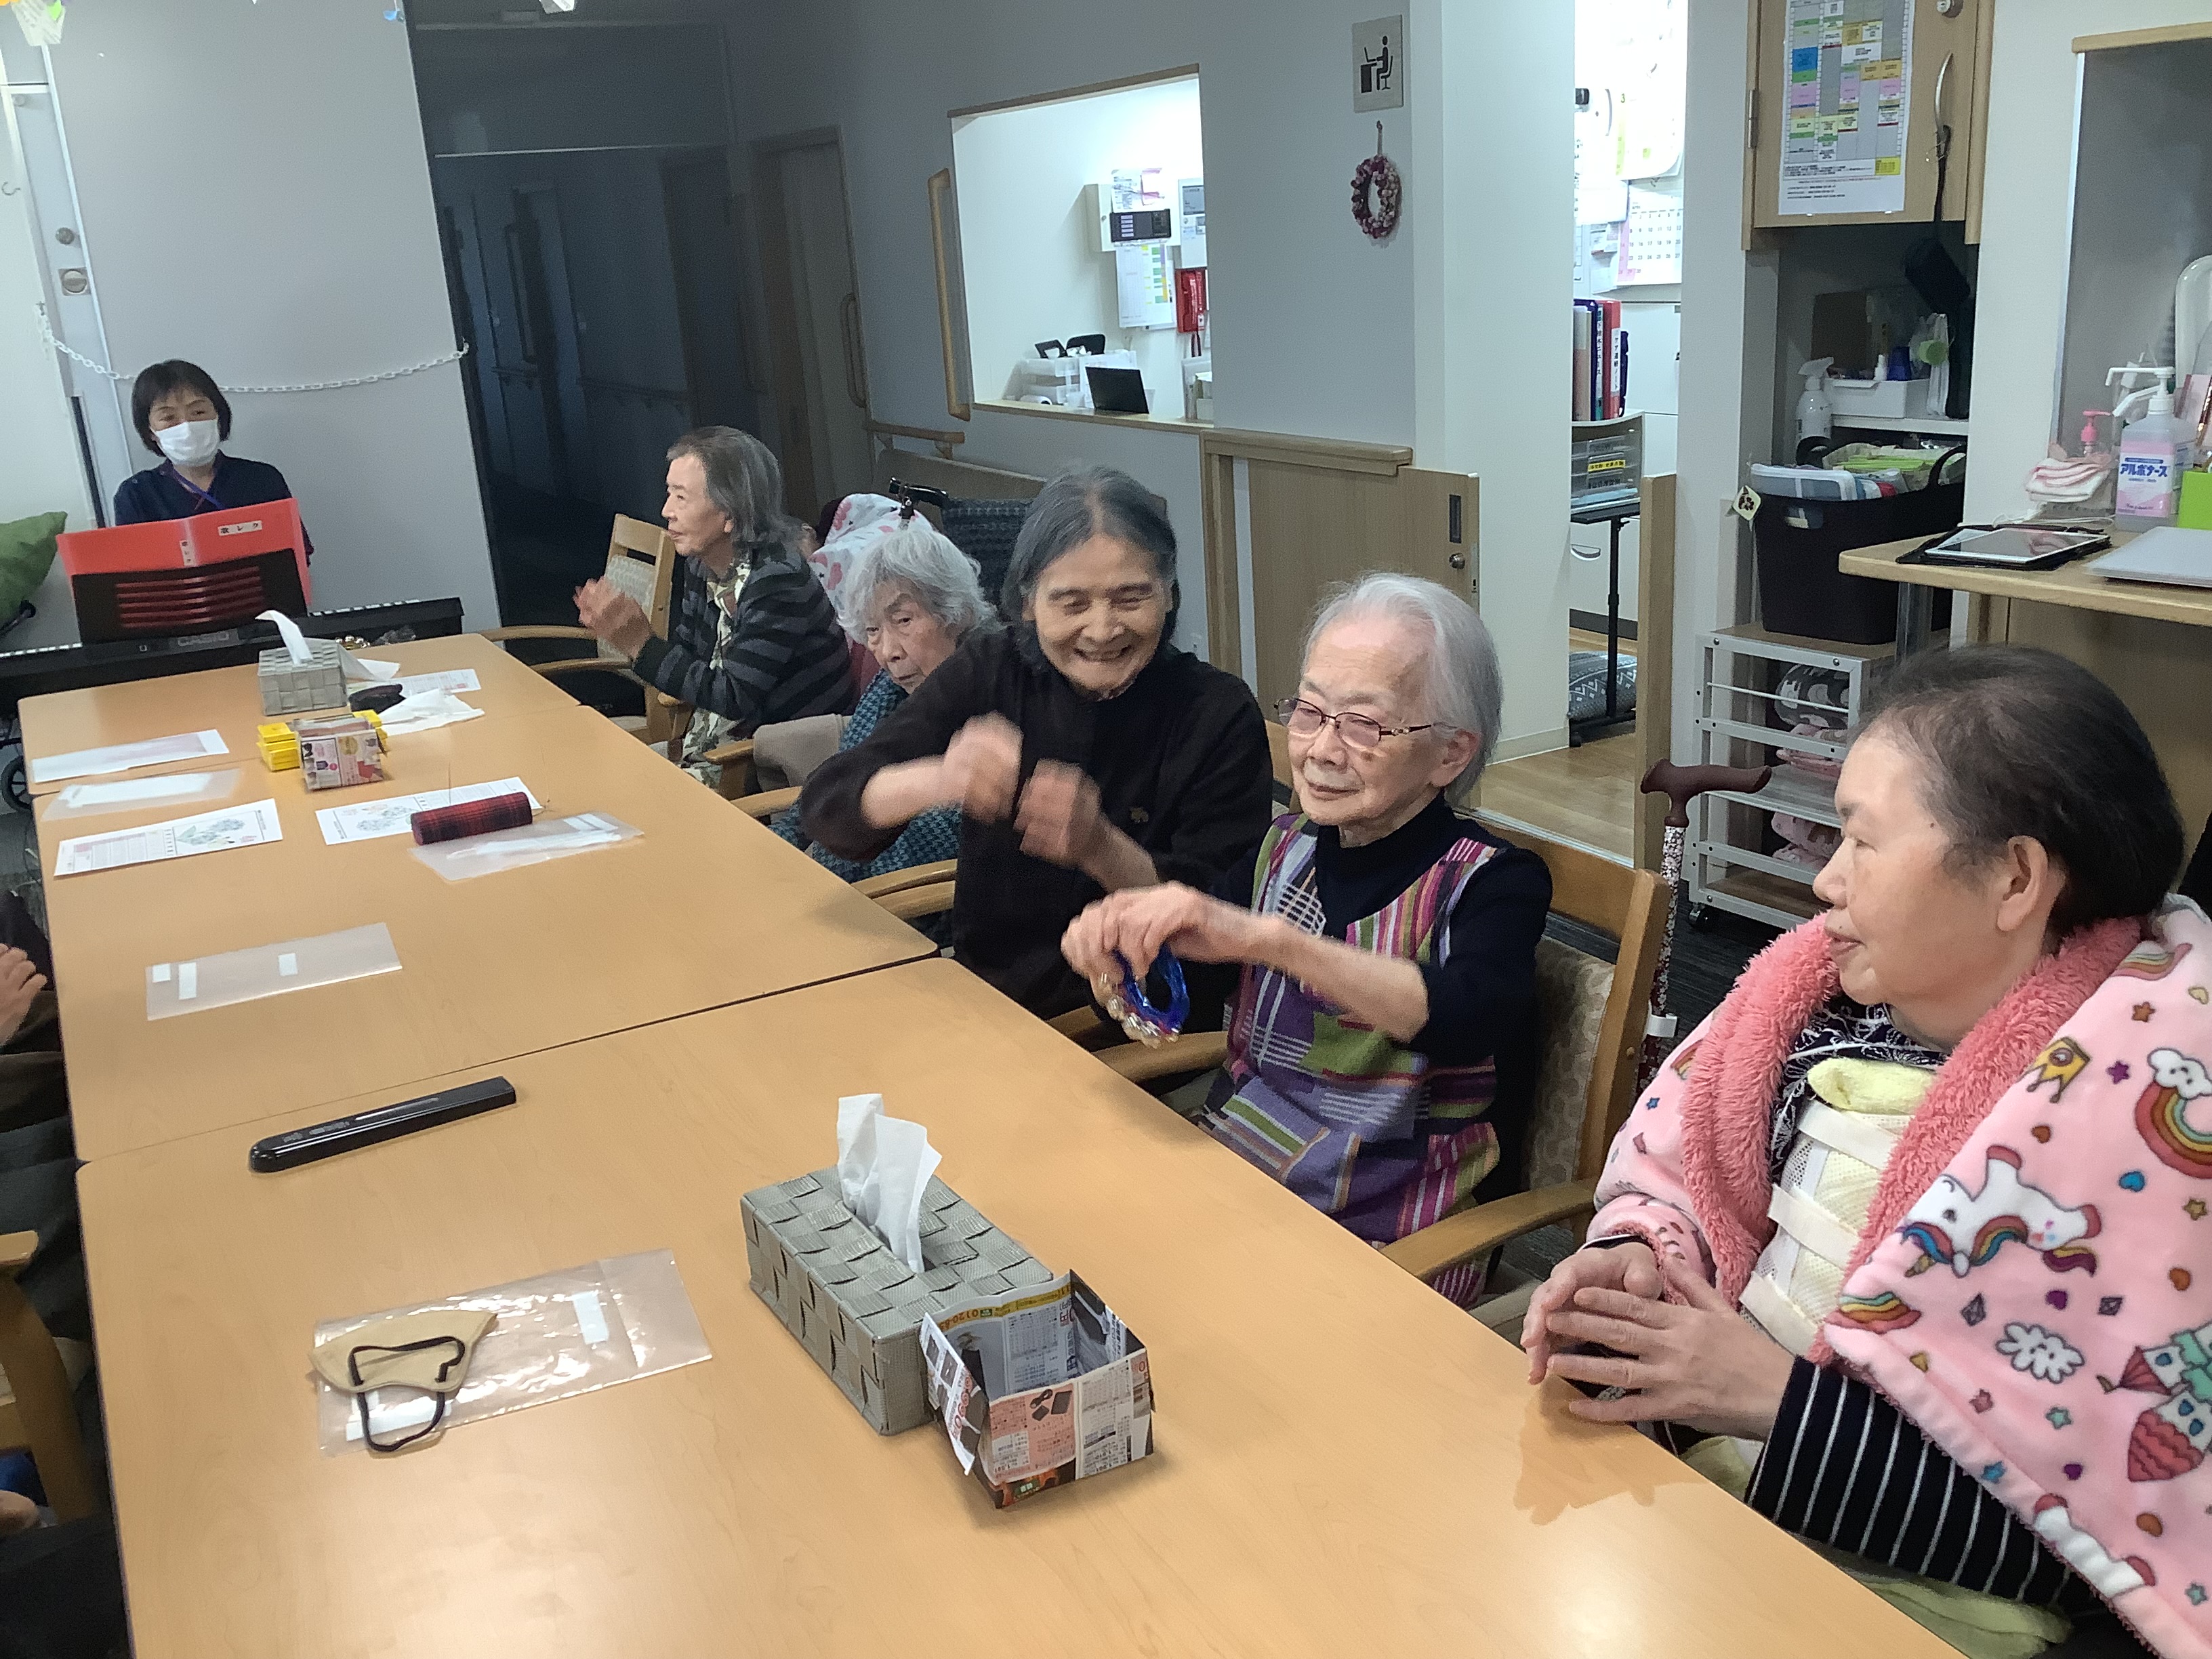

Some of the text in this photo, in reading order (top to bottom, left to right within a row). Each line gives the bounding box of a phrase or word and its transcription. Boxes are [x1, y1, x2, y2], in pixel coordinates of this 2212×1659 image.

[2120, 464, 2168, 477] アルボナース
[220, 523, 258, 534] 歌レク
[178, 631, 230, 647] CASIO
